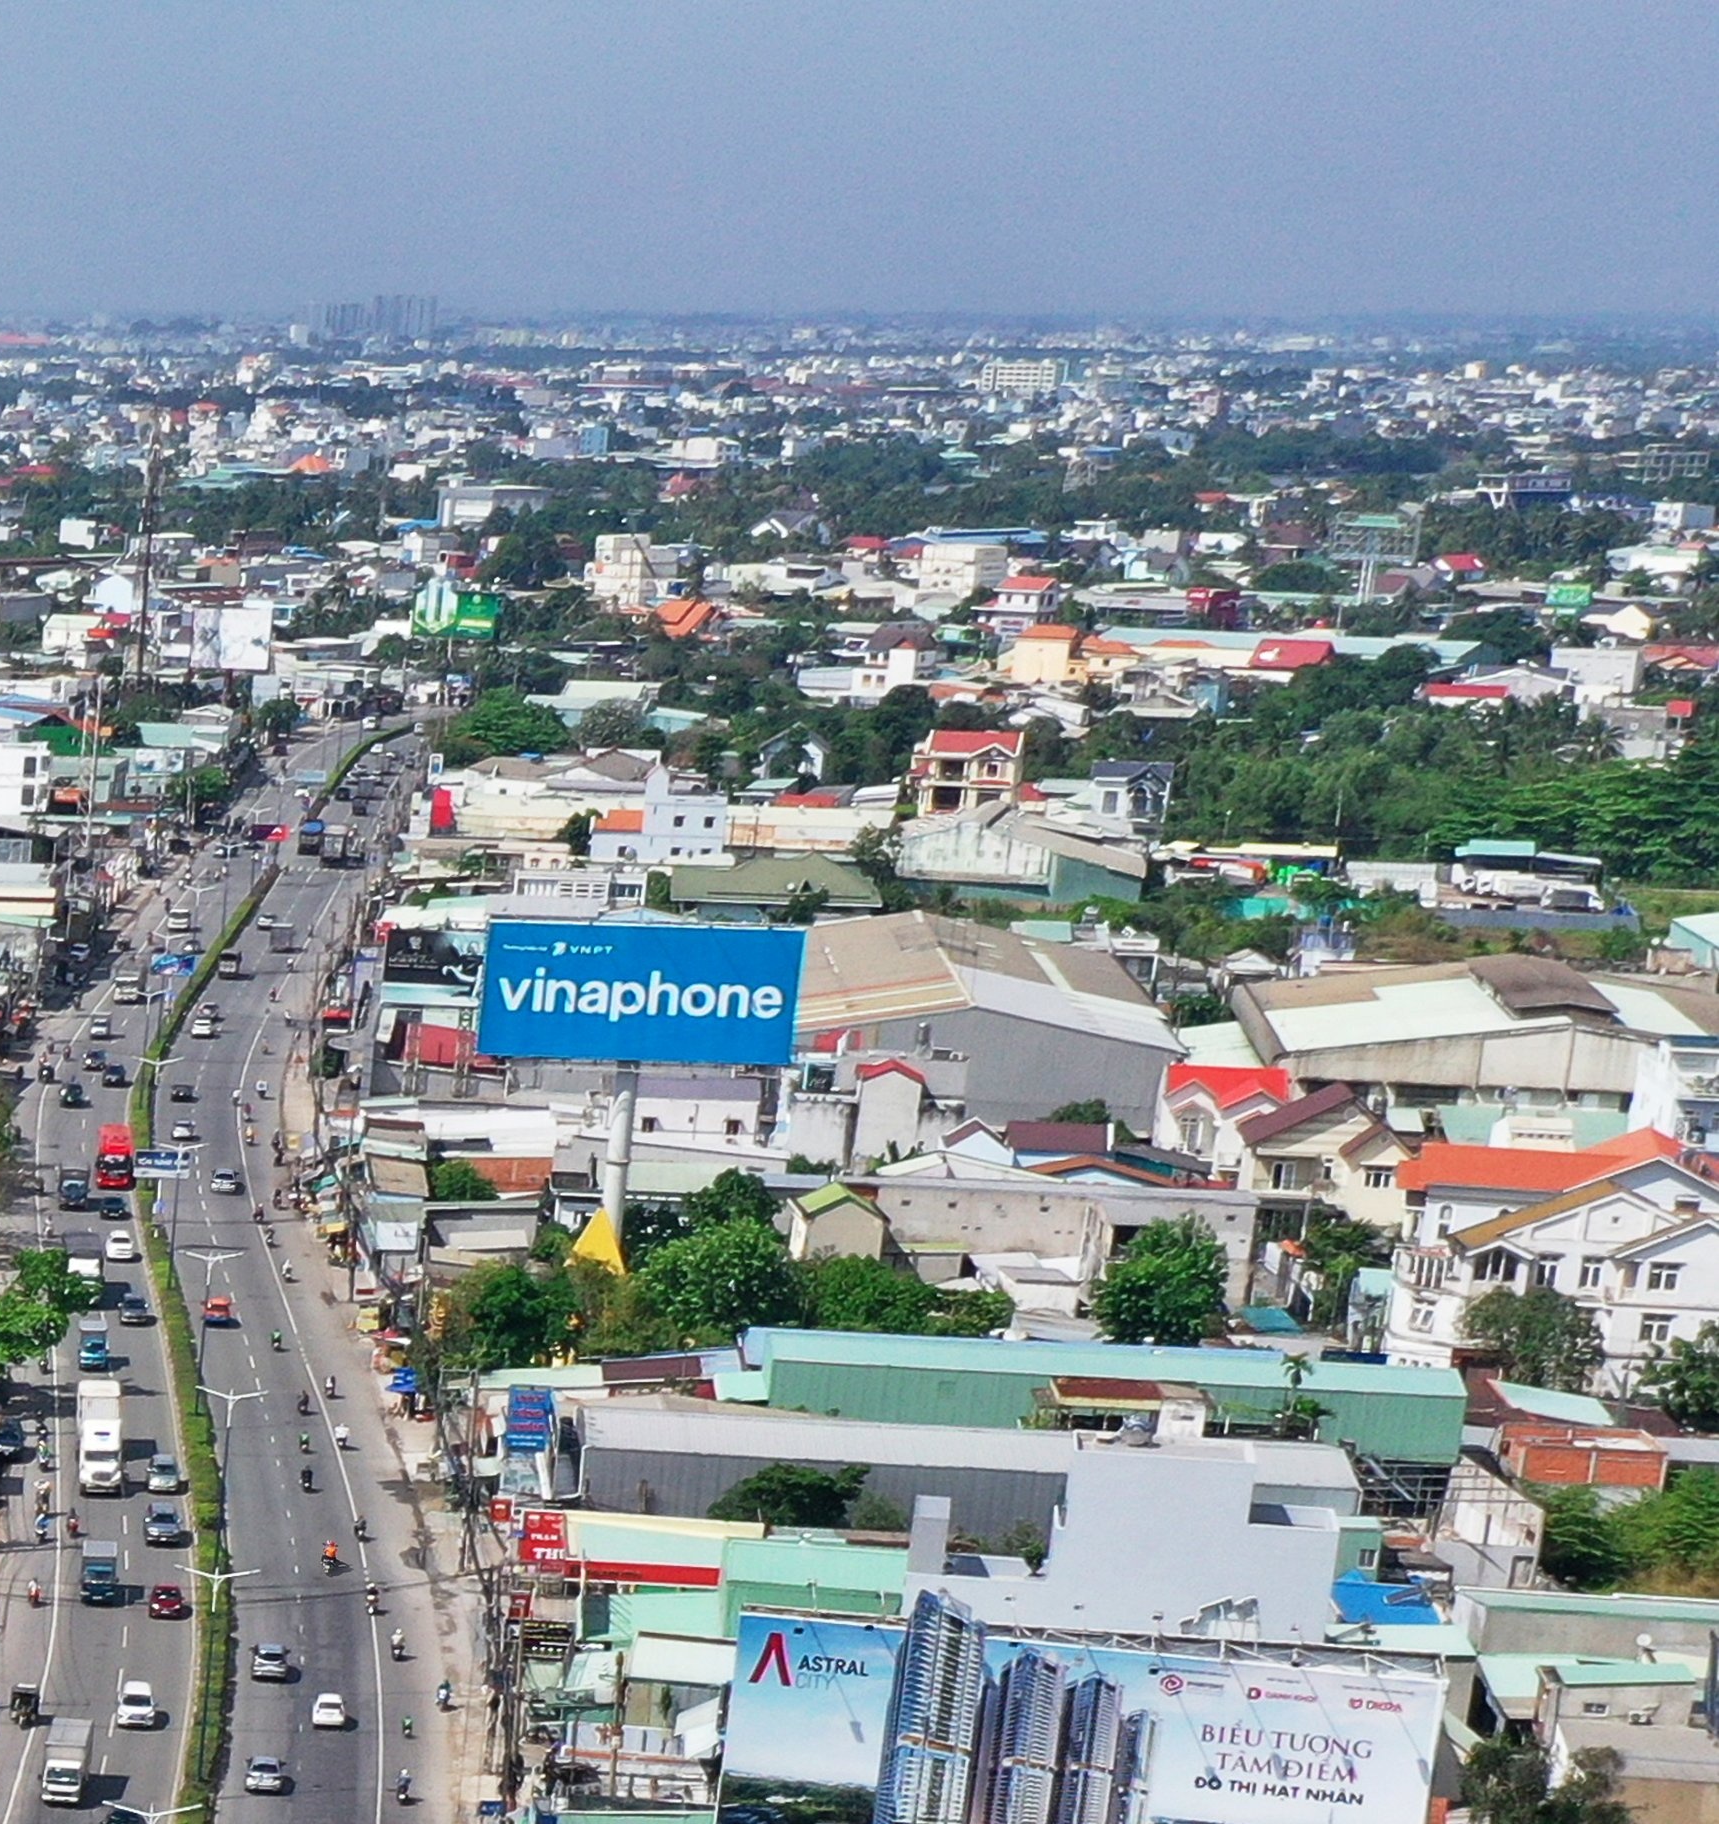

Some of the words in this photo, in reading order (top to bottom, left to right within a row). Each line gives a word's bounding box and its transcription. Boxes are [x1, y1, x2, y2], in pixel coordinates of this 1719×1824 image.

[570, 945, 613, 955] VNPT
[499, 966, 783, 1022] vinaphone
[798, 1655, 869, 1677] ASTRAL
[795, 1674, 836, 1690] CITY
[1201, 1719, 1263, 1748] BIỂU
[1271, 1730, 1373, 1759] TƯỢNG
[1215, 1750, 1273, 1775] TÂM
[1283, 1758, 1357, 1784] ĐIỂM
[1229, 1779, 1256, 1796] THỊ
[1263, 1785, 1299, 1801] HẠT
[1305, 1787, 1364, 1805] NHÂN
